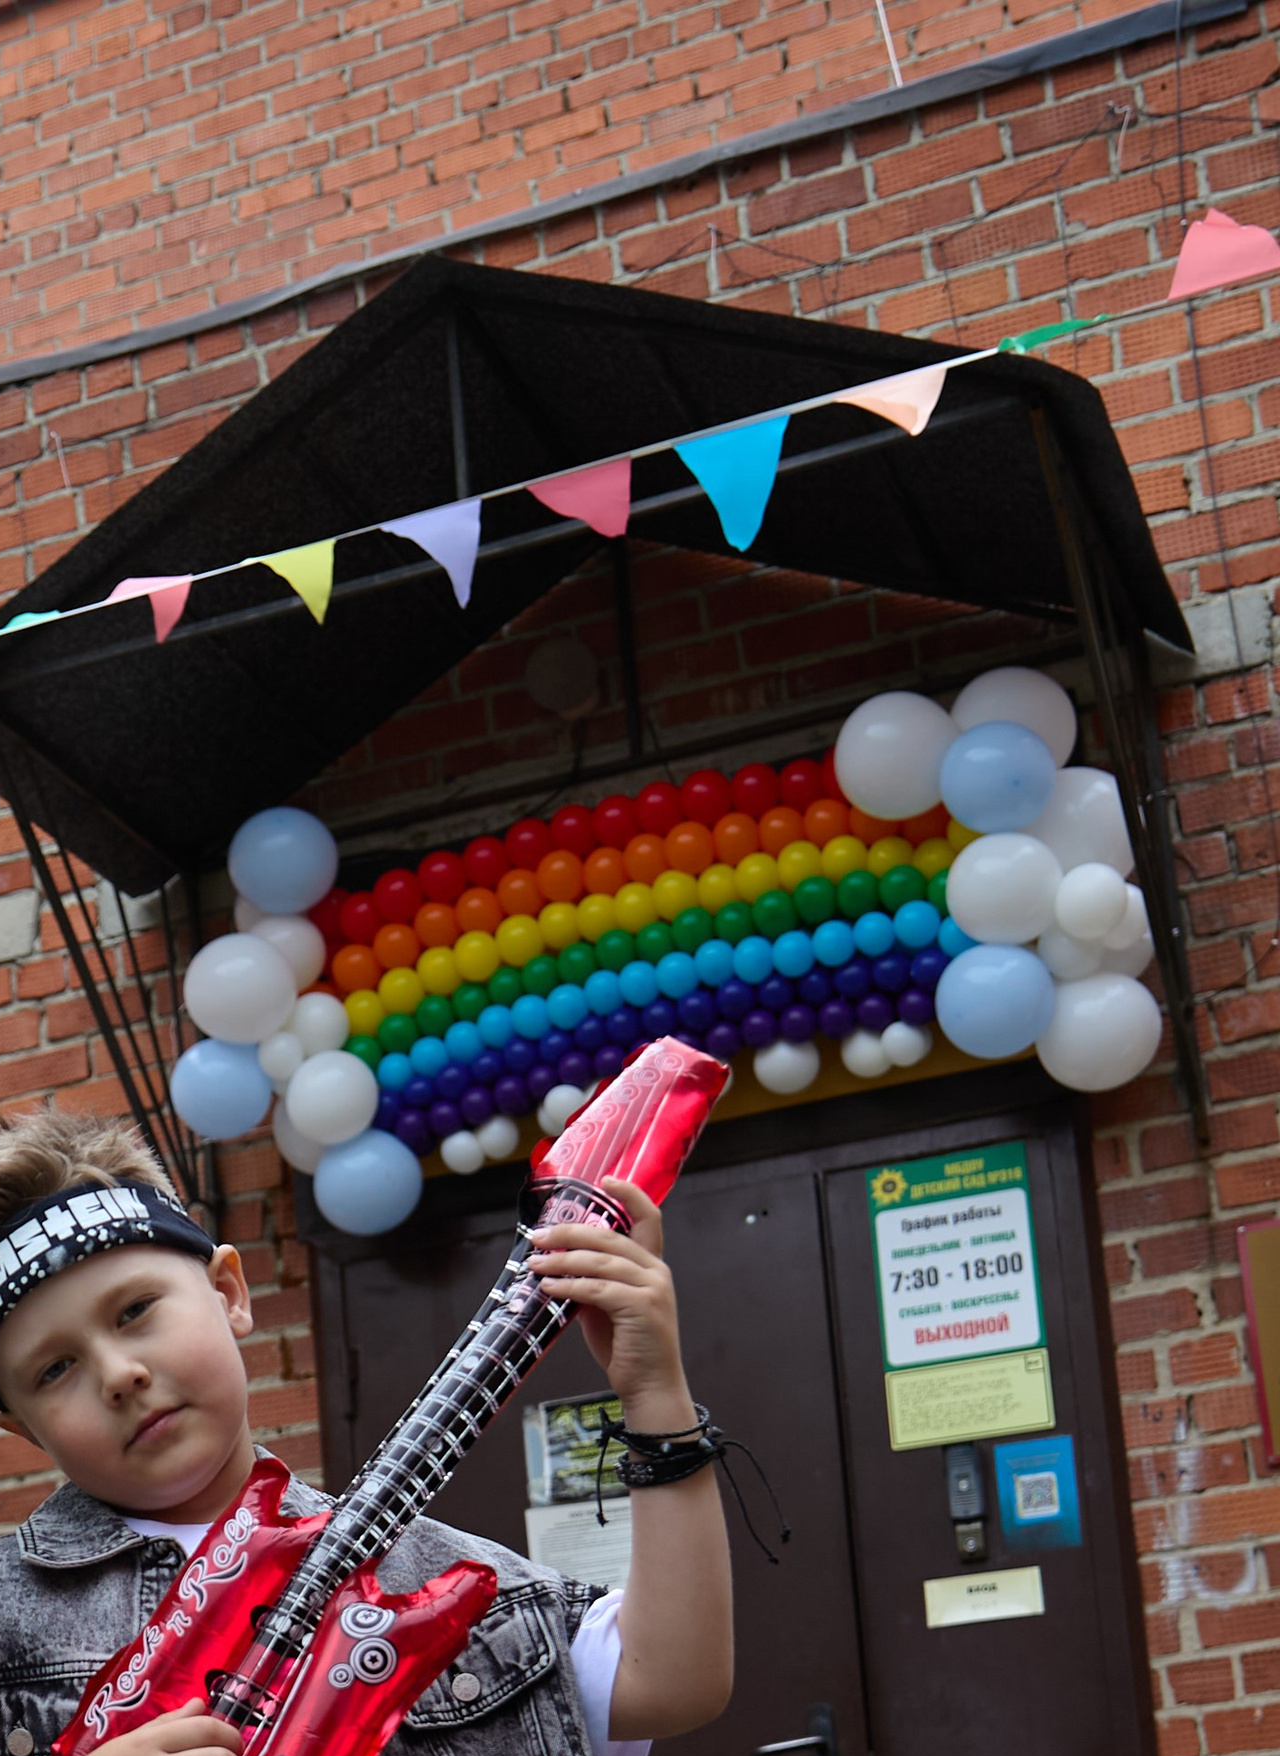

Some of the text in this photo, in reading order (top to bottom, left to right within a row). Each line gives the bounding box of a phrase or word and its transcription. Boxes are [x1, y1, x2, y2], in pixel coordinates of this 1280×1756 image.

[901, 1205, 1002, 1233] График работы
[889, 1266, 939, 1293] 7:30
[960, 1252, 1024, 1282] 18:00
[914, 1311, 1010, 1345] ВЫХОДНОЙ
[84, 1624, 165, 1739] Rock
[178, 1507, 256, 1612] Roll
